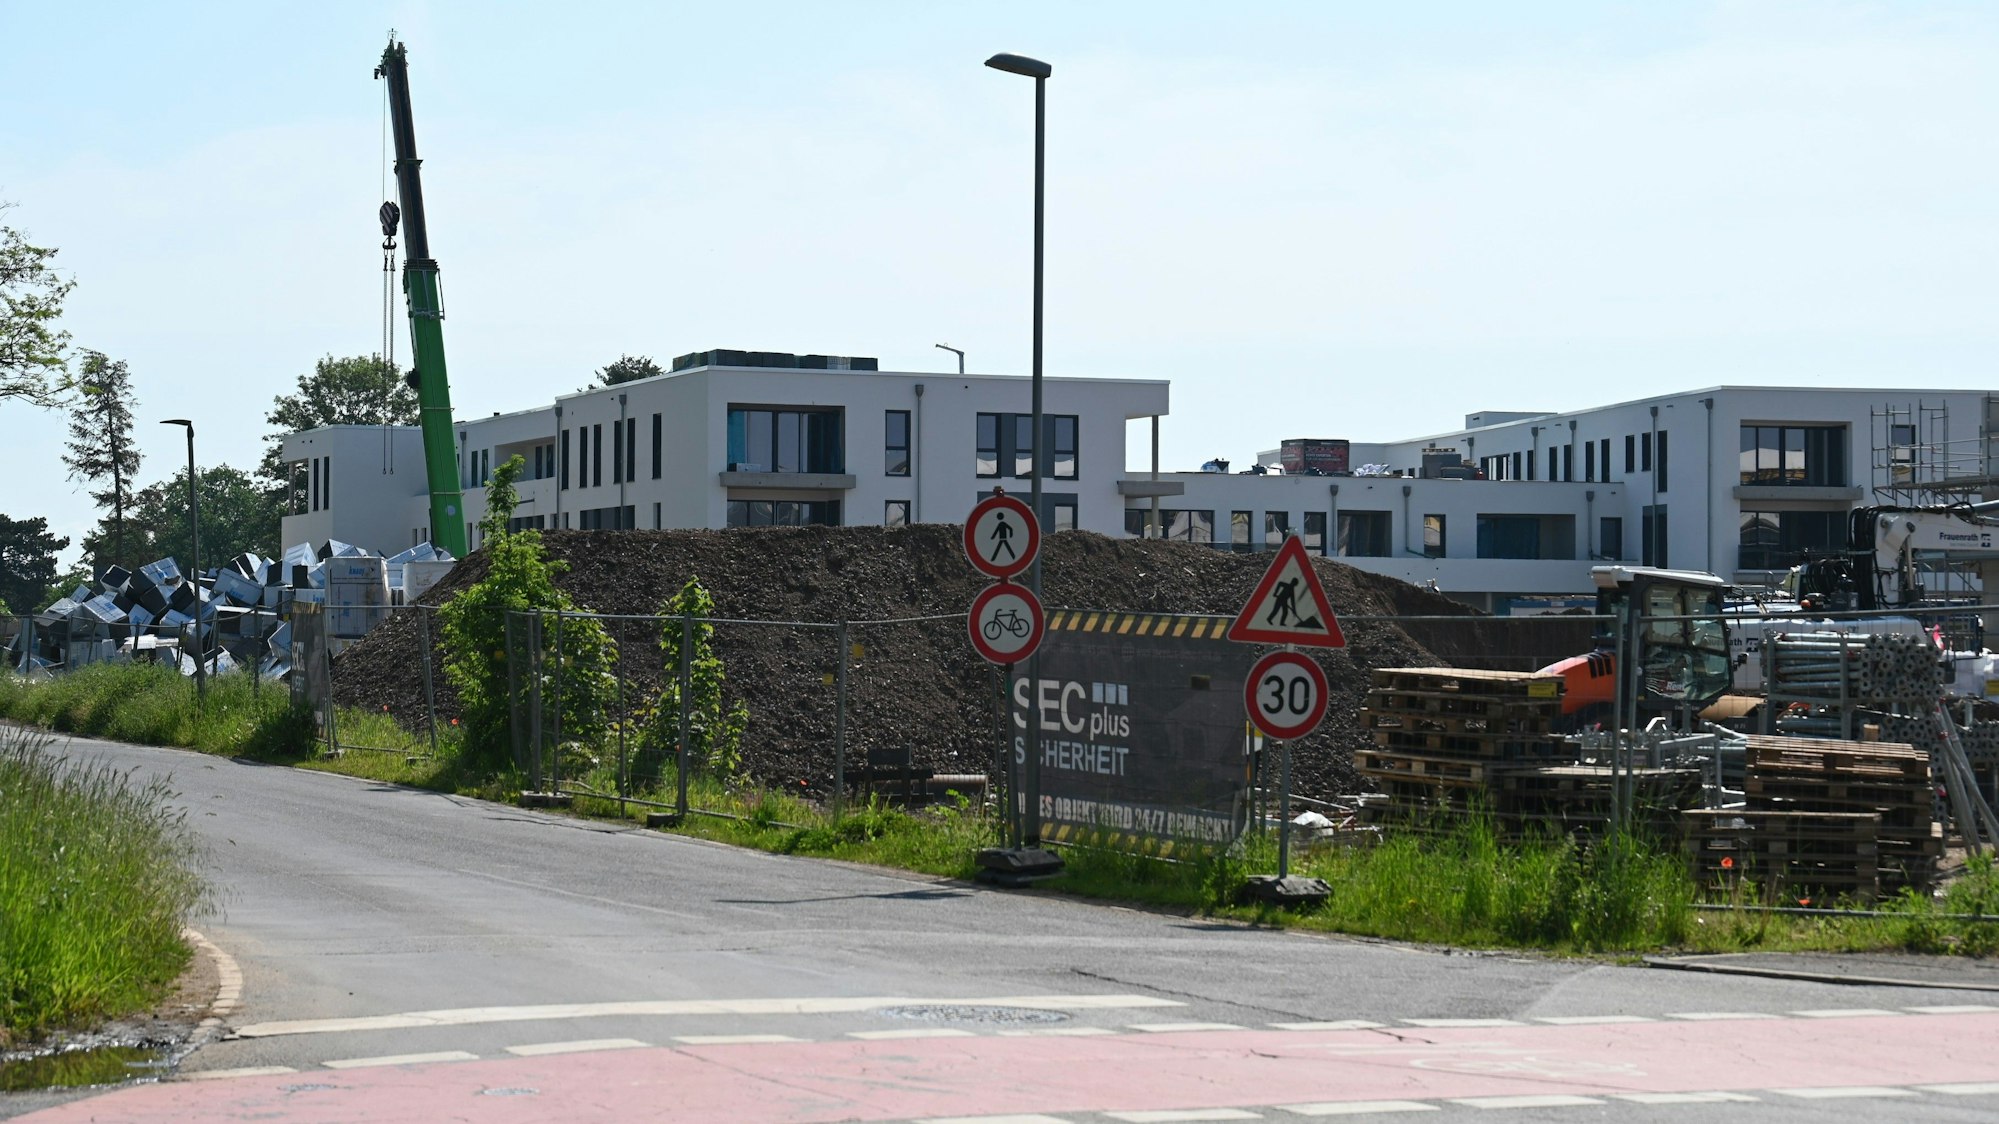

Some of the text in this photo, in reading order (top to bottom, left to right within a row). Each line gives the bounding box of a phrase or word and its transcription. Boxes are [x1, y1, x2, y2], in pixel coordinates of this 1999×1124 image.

[1939, 532, 1979, 542] Frauenrath
[1013, 677, 1130, 741] SEC plus
[1263, 675, 1310, 715] 30
[1014, 736, 1130, 777] SHERHEIT
[1055, 797, 1098, 824] OBJEKT
[1098, 803, 1132, 830] WIRD
[1134, 808, 1165, 834] 24/7
